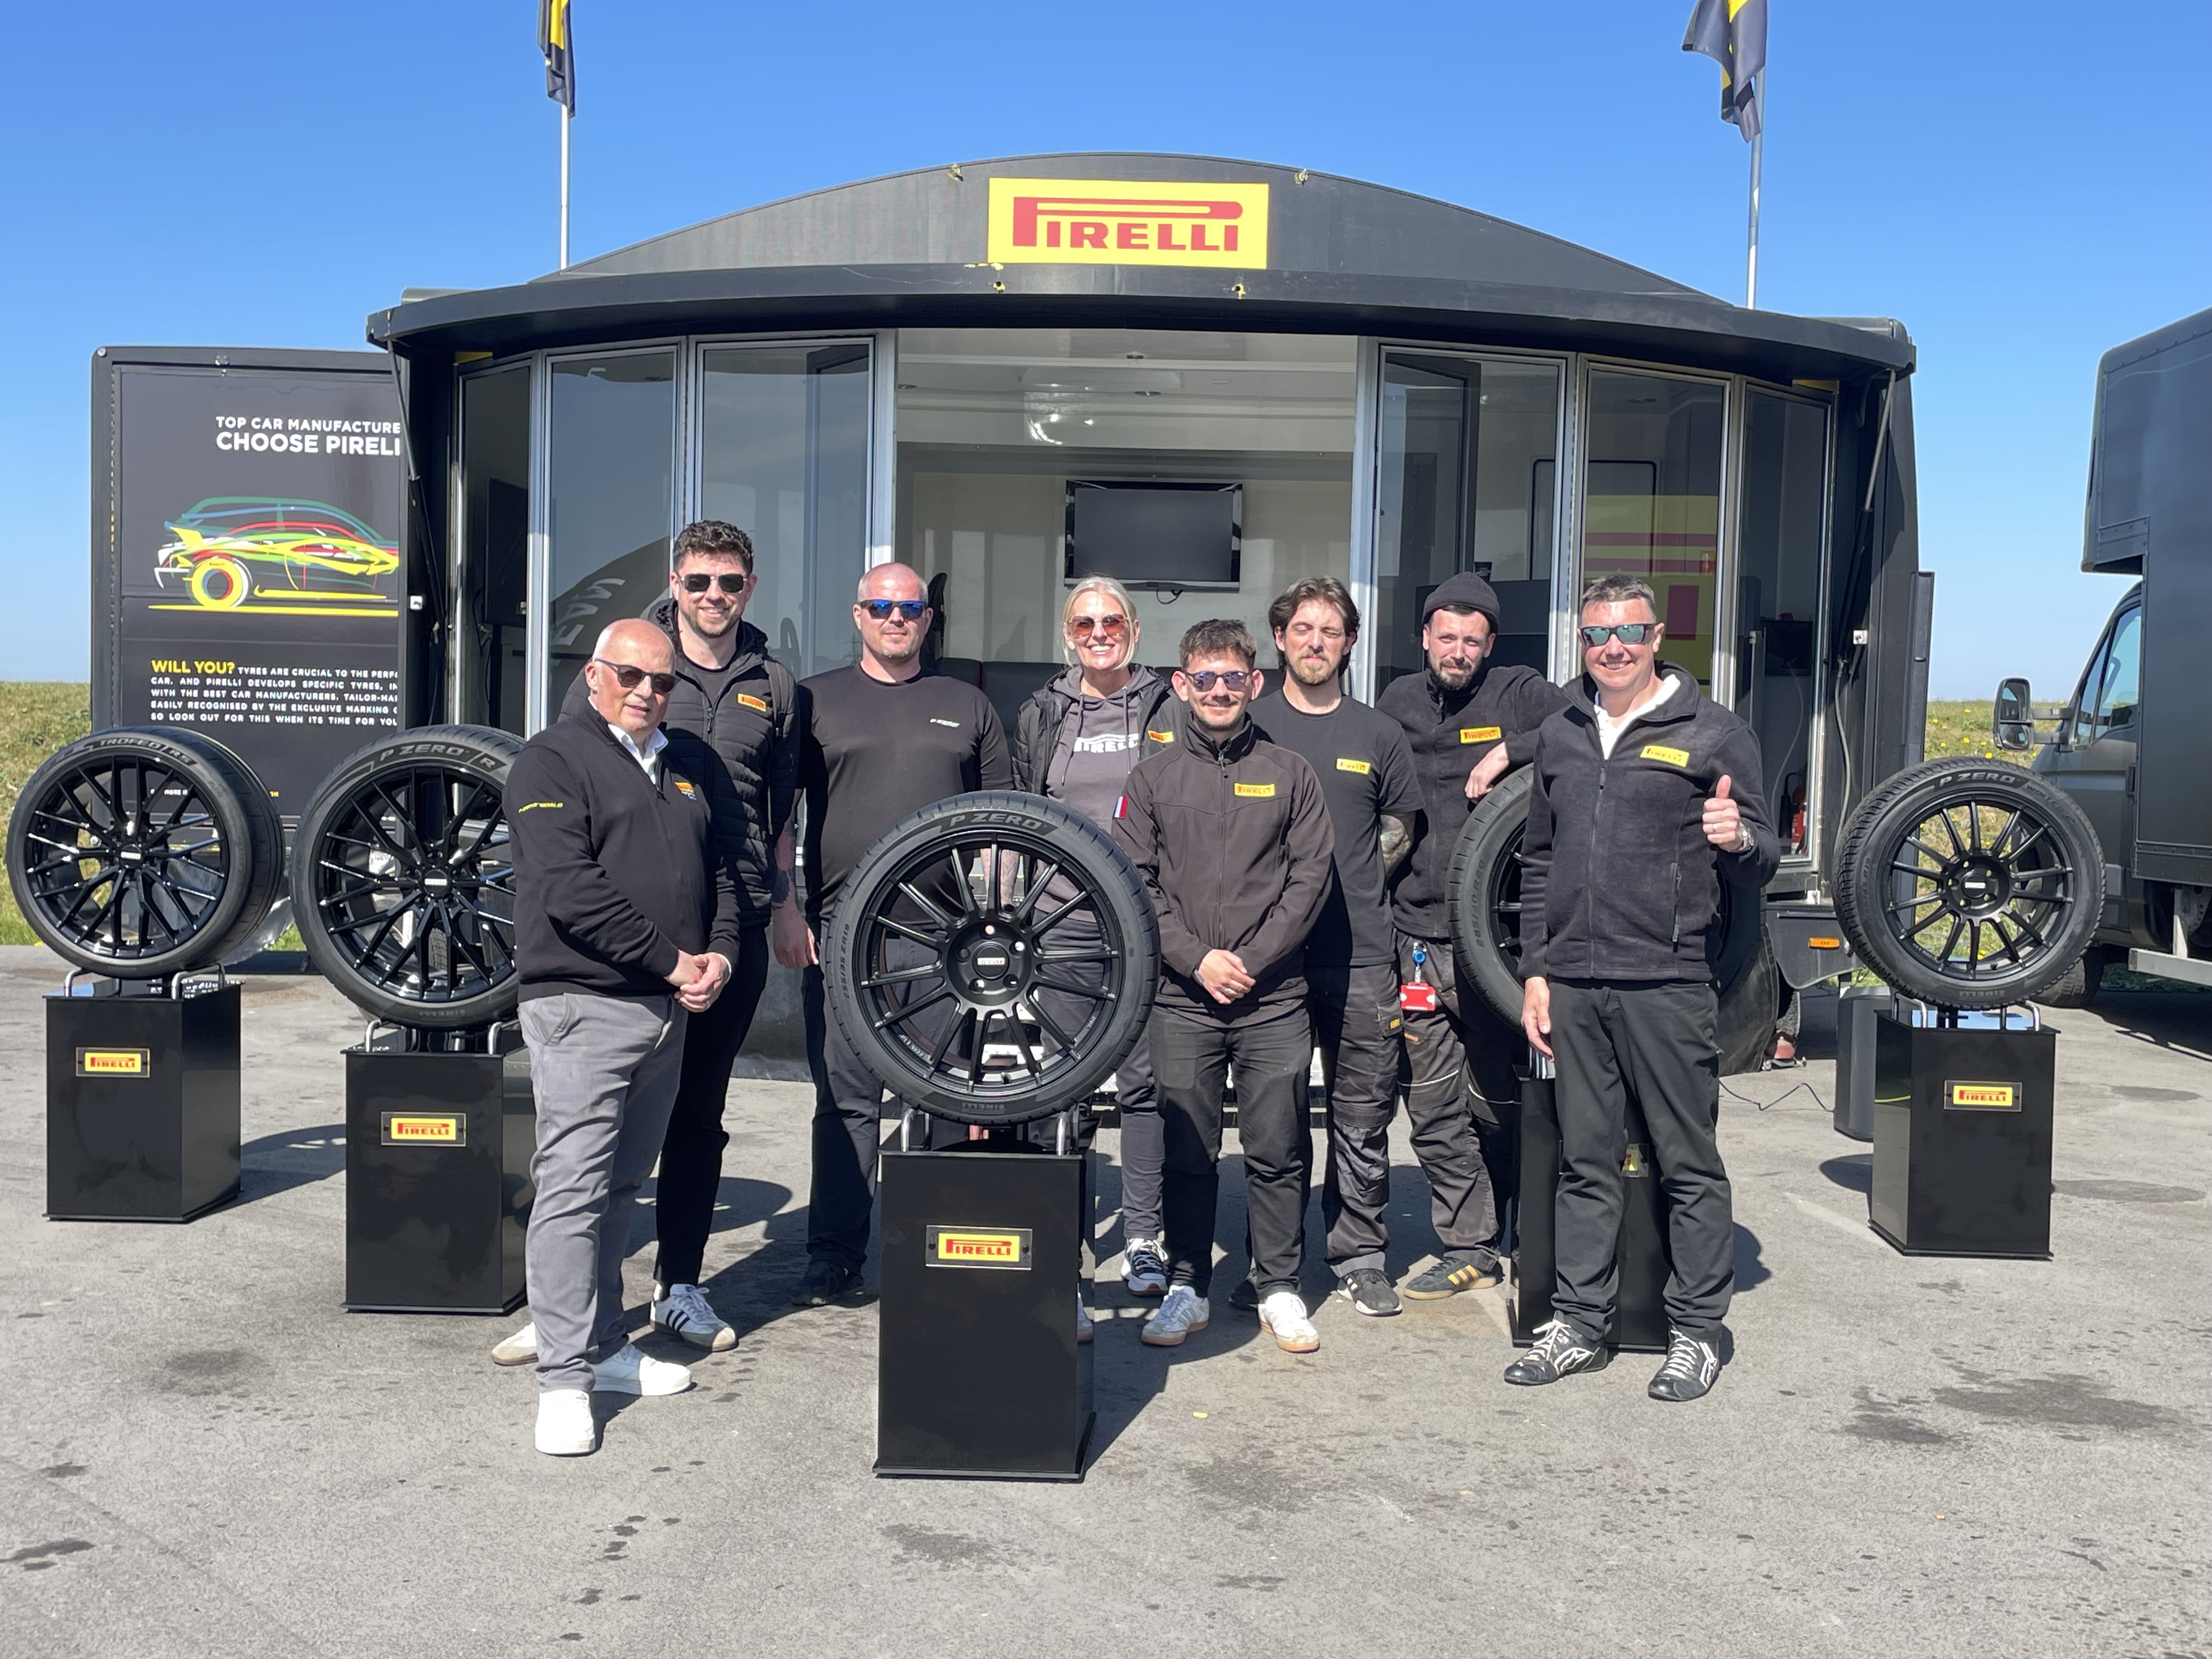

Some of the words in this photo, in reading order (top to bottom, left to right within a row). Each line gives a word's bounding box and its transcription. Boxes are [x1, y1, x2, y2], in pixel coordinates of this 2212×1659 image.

[1013, 196, 1243, 252] PIRELLI
[216, 416, 246, 428] TOP
[251, 417, 283, 430] CAR
[216, 431, 318, 453] CHOOSE
[151, 660, 190, 673] WILL
[194, 661, 235, 674] YOU?
[238, 667, 267, 675] TYRES
[270, 668, 289, 676] ARE
[292, 668, 332, 677] CRUCIAL
[206, 678, 241, 686] PIRELLI
[248, 679, 296, 688] DEVELOPS
[302, 680, 345, 689] SPECIFIC
[180, 690, 199, 698] THE
[203, 690, 227, 698] BEST
[232, 690, 251, 698] CAR
[151, 701, 183, 709] EASILY
[188, 701, 247, 710] RECOGNISED
[252, 703, 264, 711] BY
[269, 703, 286, 712] THE
[291, 704, 342, 713] EXCLUSIVE
[346, 705, 388, 714] MARKING
[151, 713, 164, 721] SO
[169, 713, 195, 721] LOOK
[200, 714, 219, 722] OUT
[224, 714, 244, 722] FOR
[249, 714, 270, 723] THIS
[275, 715, 303, 724] WHEN
[308, 716, 323, 724] ITS
[329, 716, 350, 725] TIME
[356, 717, 375, 725] FOR
[1074, 733, 1139, 753] PIRELL
[380, 749, 394, 761] P
[399, 744, 465, 756] ZERO
[479, 757, 495, 768] R
[1939, 776, 1952, 787] P
[1957, 772, 2016, 783] ZERO
[950, 815, 966, 826] P
[971, 813, 1042, 830] ZERO
[91, 1057, 135, 1068] PIRELLI
[1959, 1090, 2006, 1102] PIRELLI
[398, 1123, 449, 1135] PIRELLI
[946, 1239, 1012, 1256] PIRELLI
